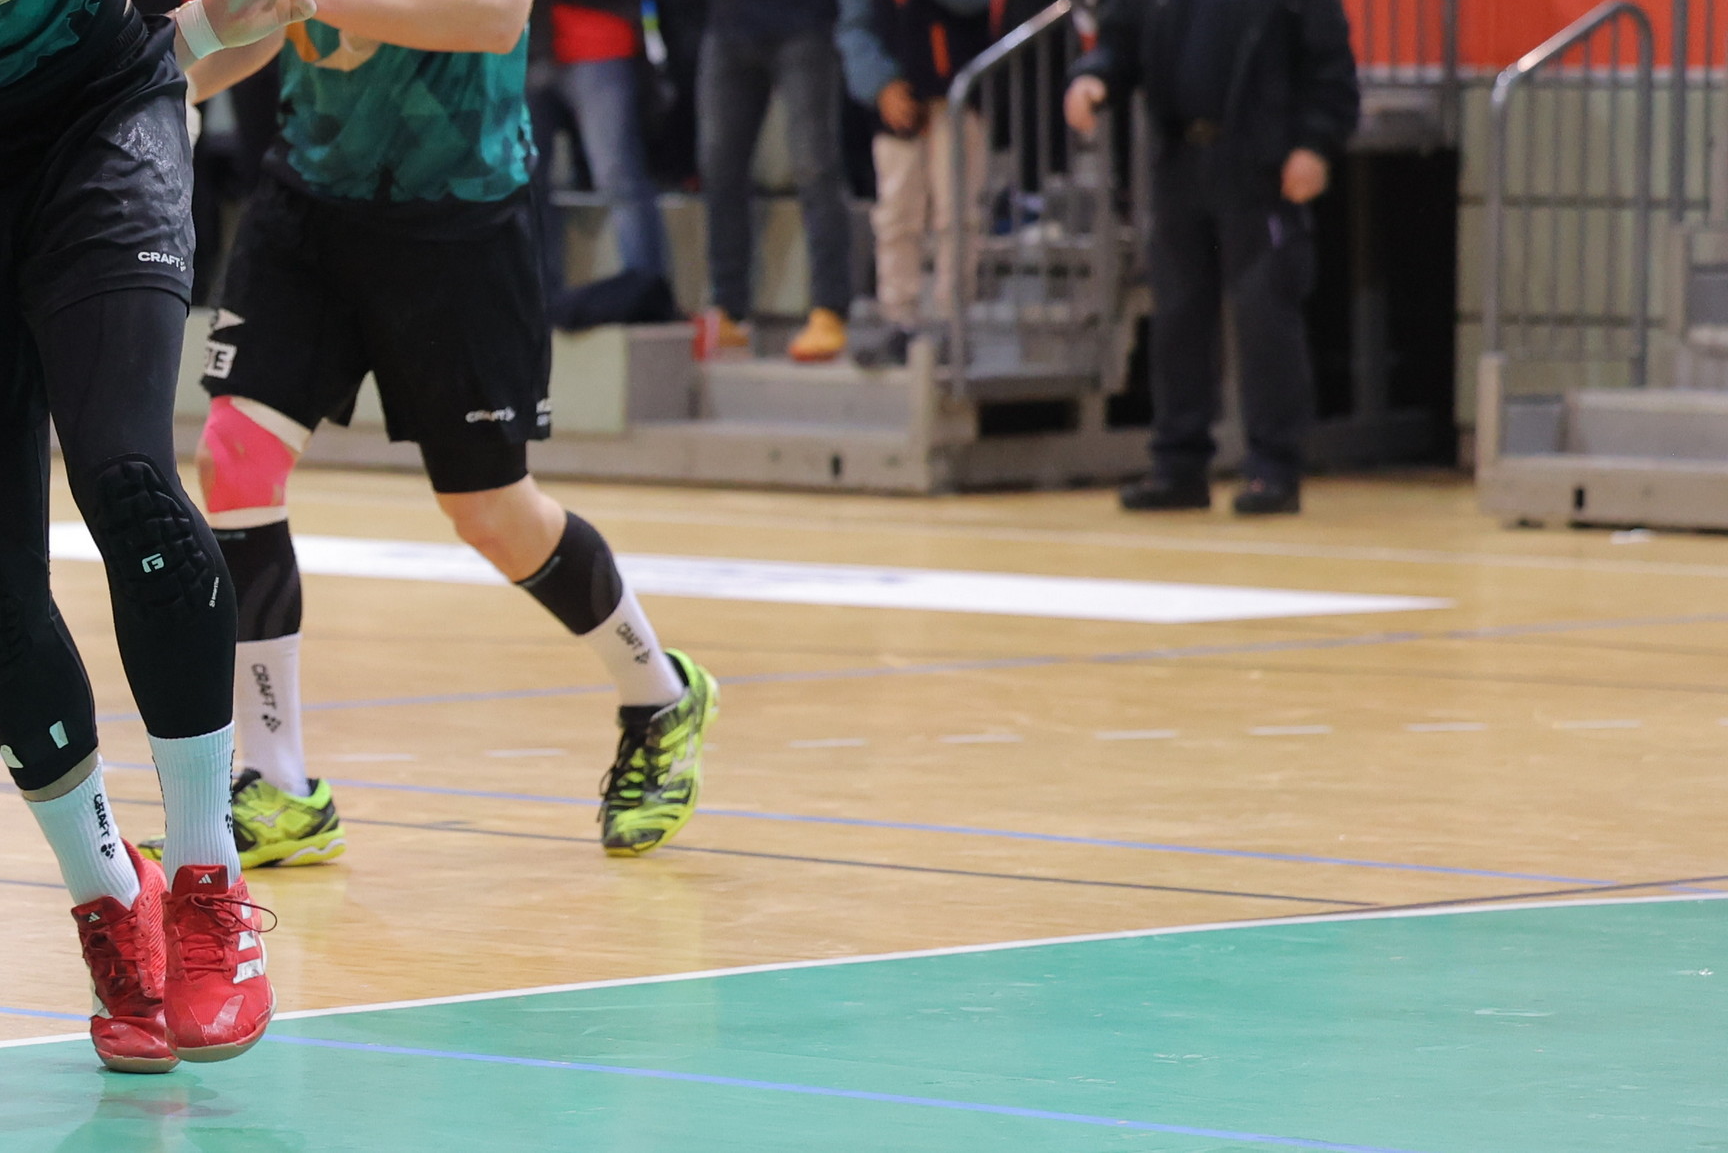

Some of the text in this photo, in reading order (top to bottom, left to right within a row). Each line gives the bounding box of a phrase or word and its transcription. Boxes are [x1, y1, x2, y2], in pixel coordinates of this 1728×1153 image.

[137, 251, 180, 268] CRAFT
[615, 621, 644, 651] CRAFT
[251, 662, 277, 711] CRAFT
[94, 793, 110, 838] CRAFT
